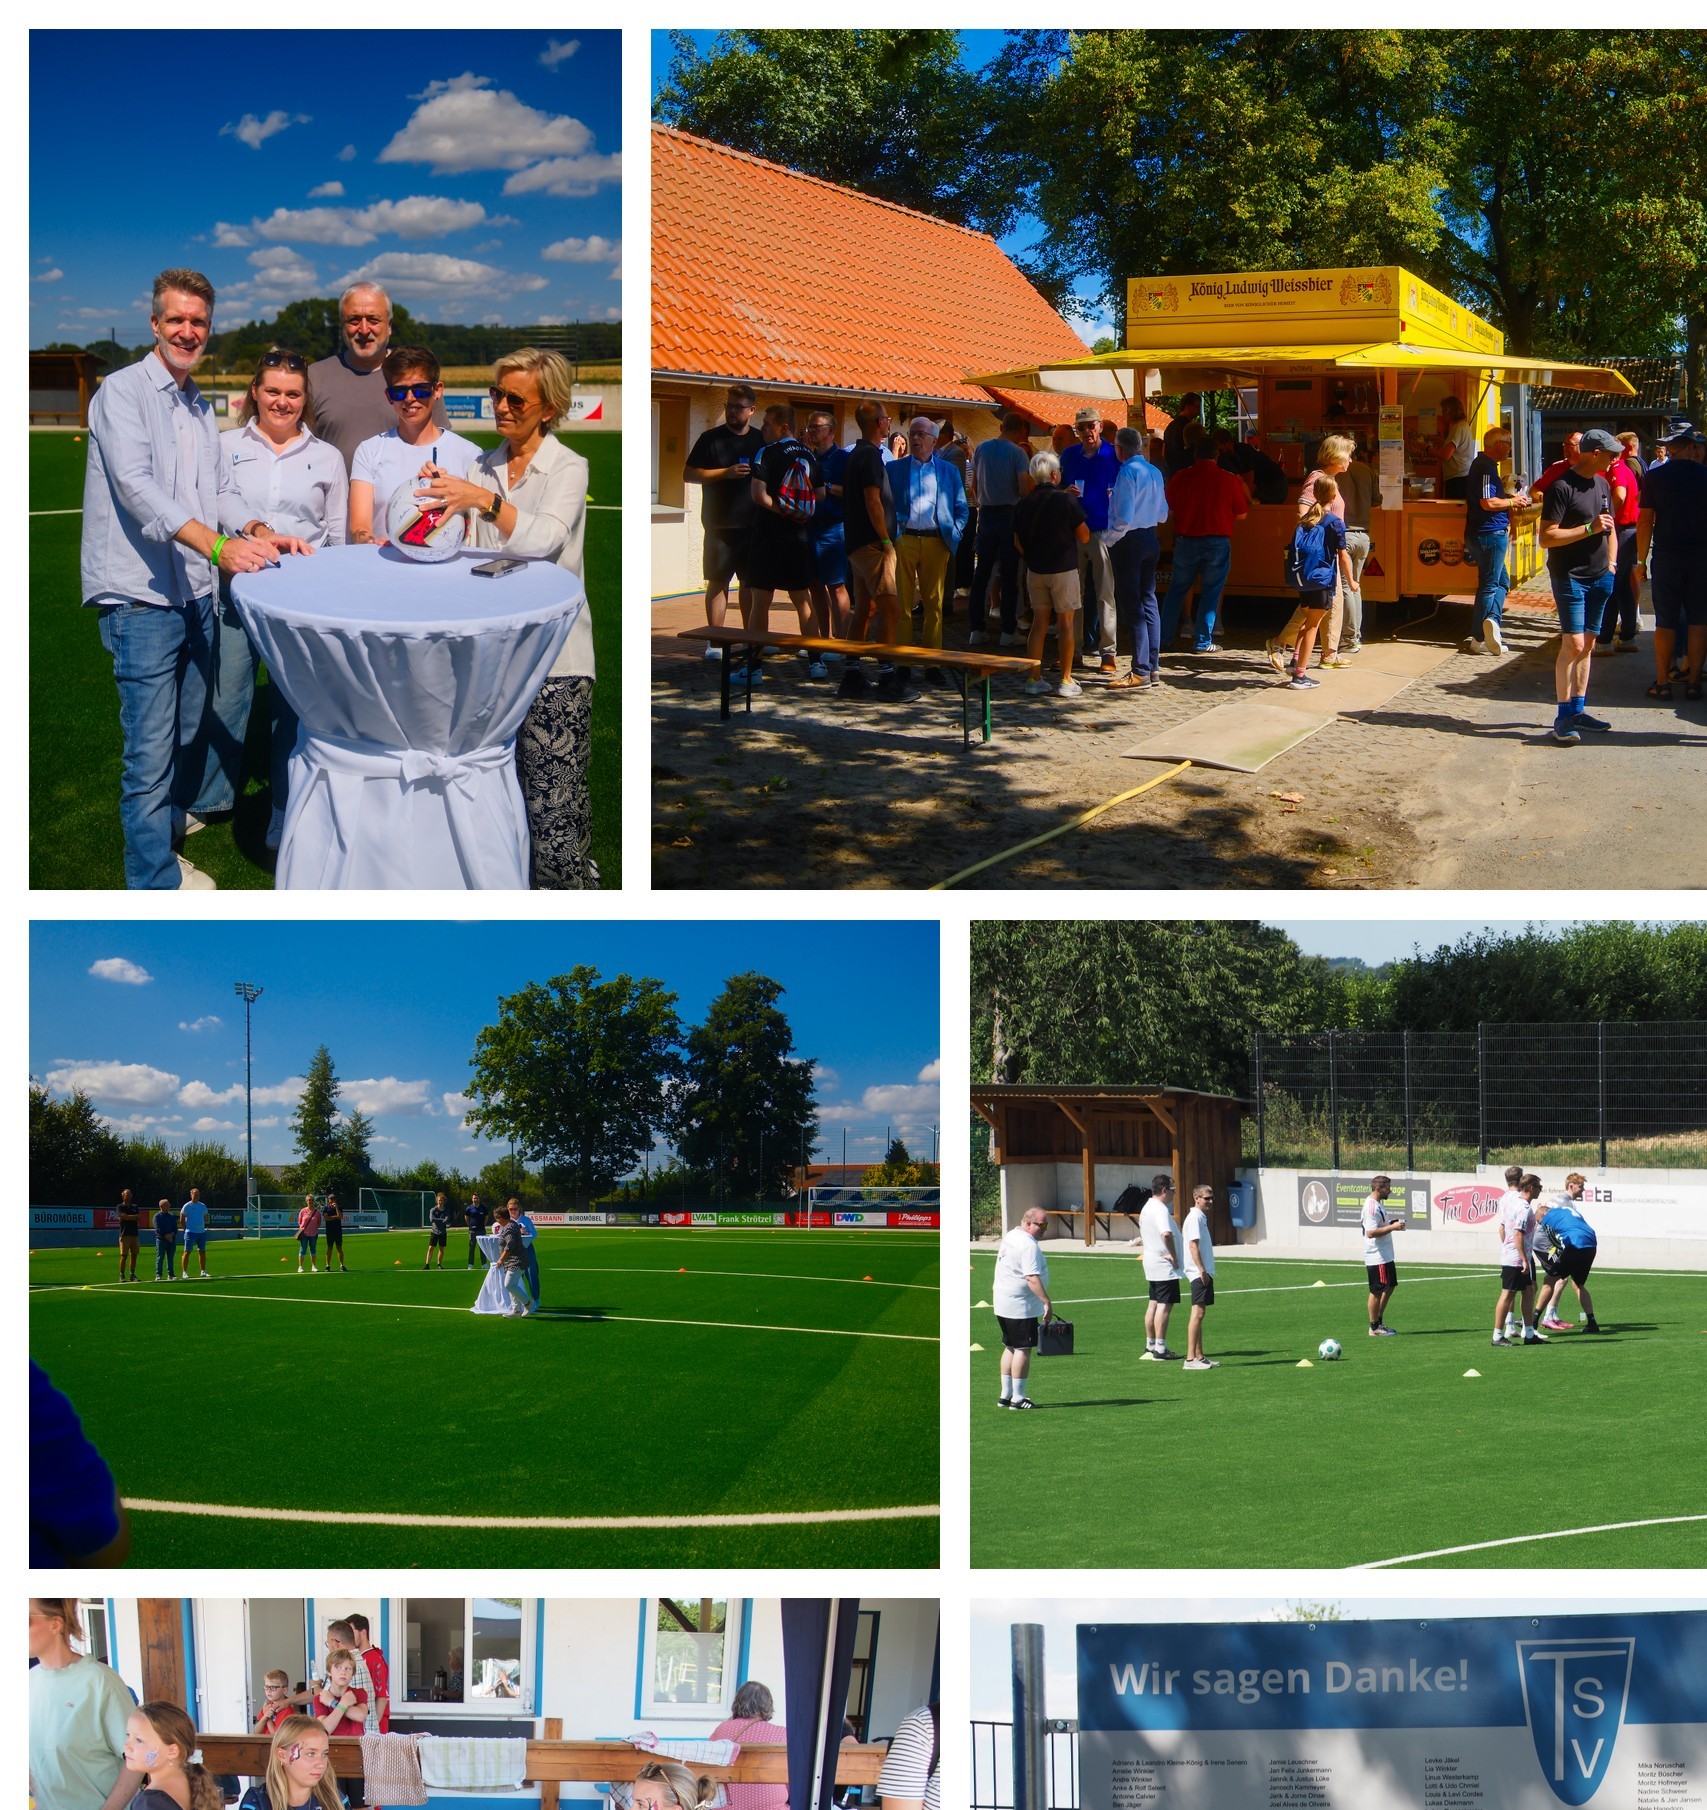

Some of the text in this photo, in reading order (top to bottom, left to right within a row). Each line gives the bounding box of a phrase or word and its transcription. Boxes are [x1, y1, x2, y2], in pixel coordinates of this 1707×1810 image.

[1189, 277, 1334, 301] König Ludwig Weissbier
[1441, 1196, 1462, 1225] Taxi
[33, 1210, 88, 1225] BÜROMÖBEL
[530, 1213, 602, 1222] ASSMANN BÜROMÖBEL
[692, 1213, 772, 1223] LVM Frank Strötzel
[835, 1214, 865, 1223] DWD
[898, 1213, 932, 1223] Philipps
[1109, 1658, 1469, 1704] Wir sagen Danke!
